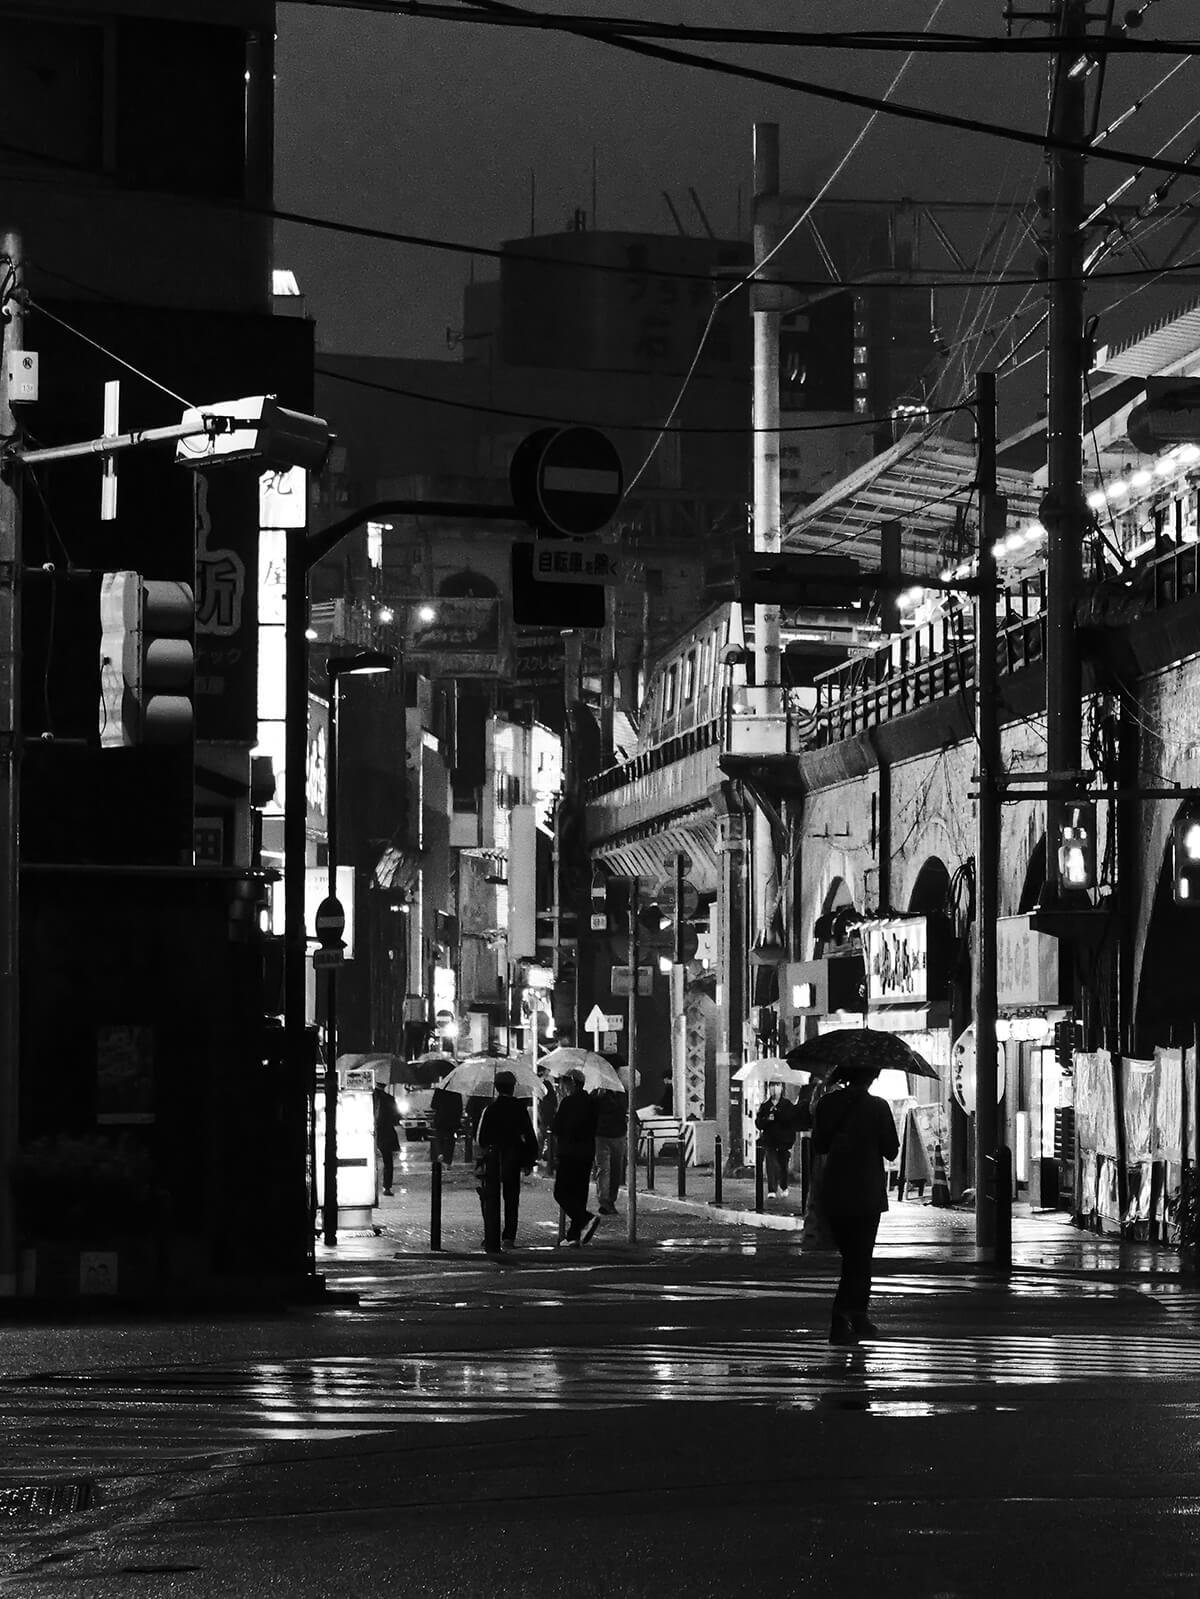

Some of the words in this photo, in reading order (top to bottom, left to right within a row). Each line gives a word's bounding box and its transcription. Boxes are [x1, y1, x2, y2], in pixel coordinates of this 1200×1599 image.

[539, 551, 618, 576] 自転車を除く
